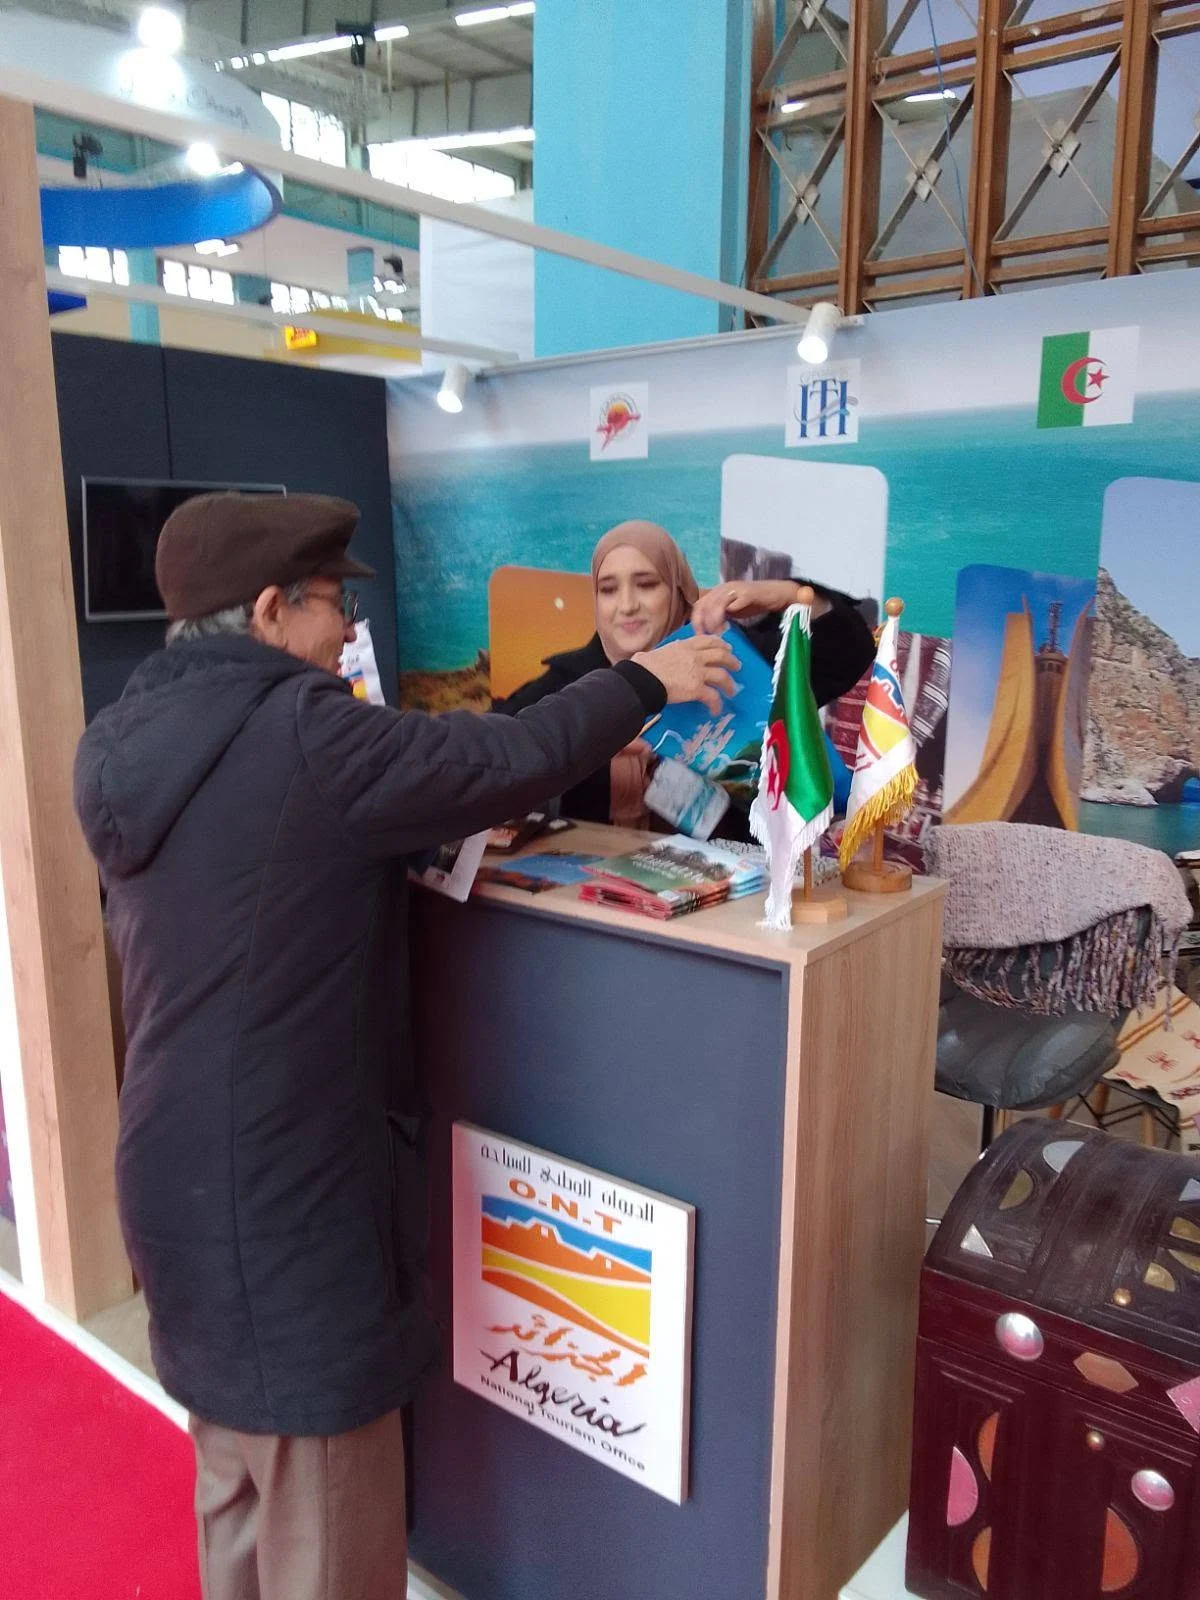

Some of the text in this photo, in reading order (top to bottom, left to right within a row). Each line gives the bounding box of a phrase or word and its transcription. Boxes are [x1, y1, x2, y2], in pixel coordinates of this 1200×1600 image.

[479, 1348, 648, 1437] Algeria
[480, 1375, 646, 1471] National Tourism Office
